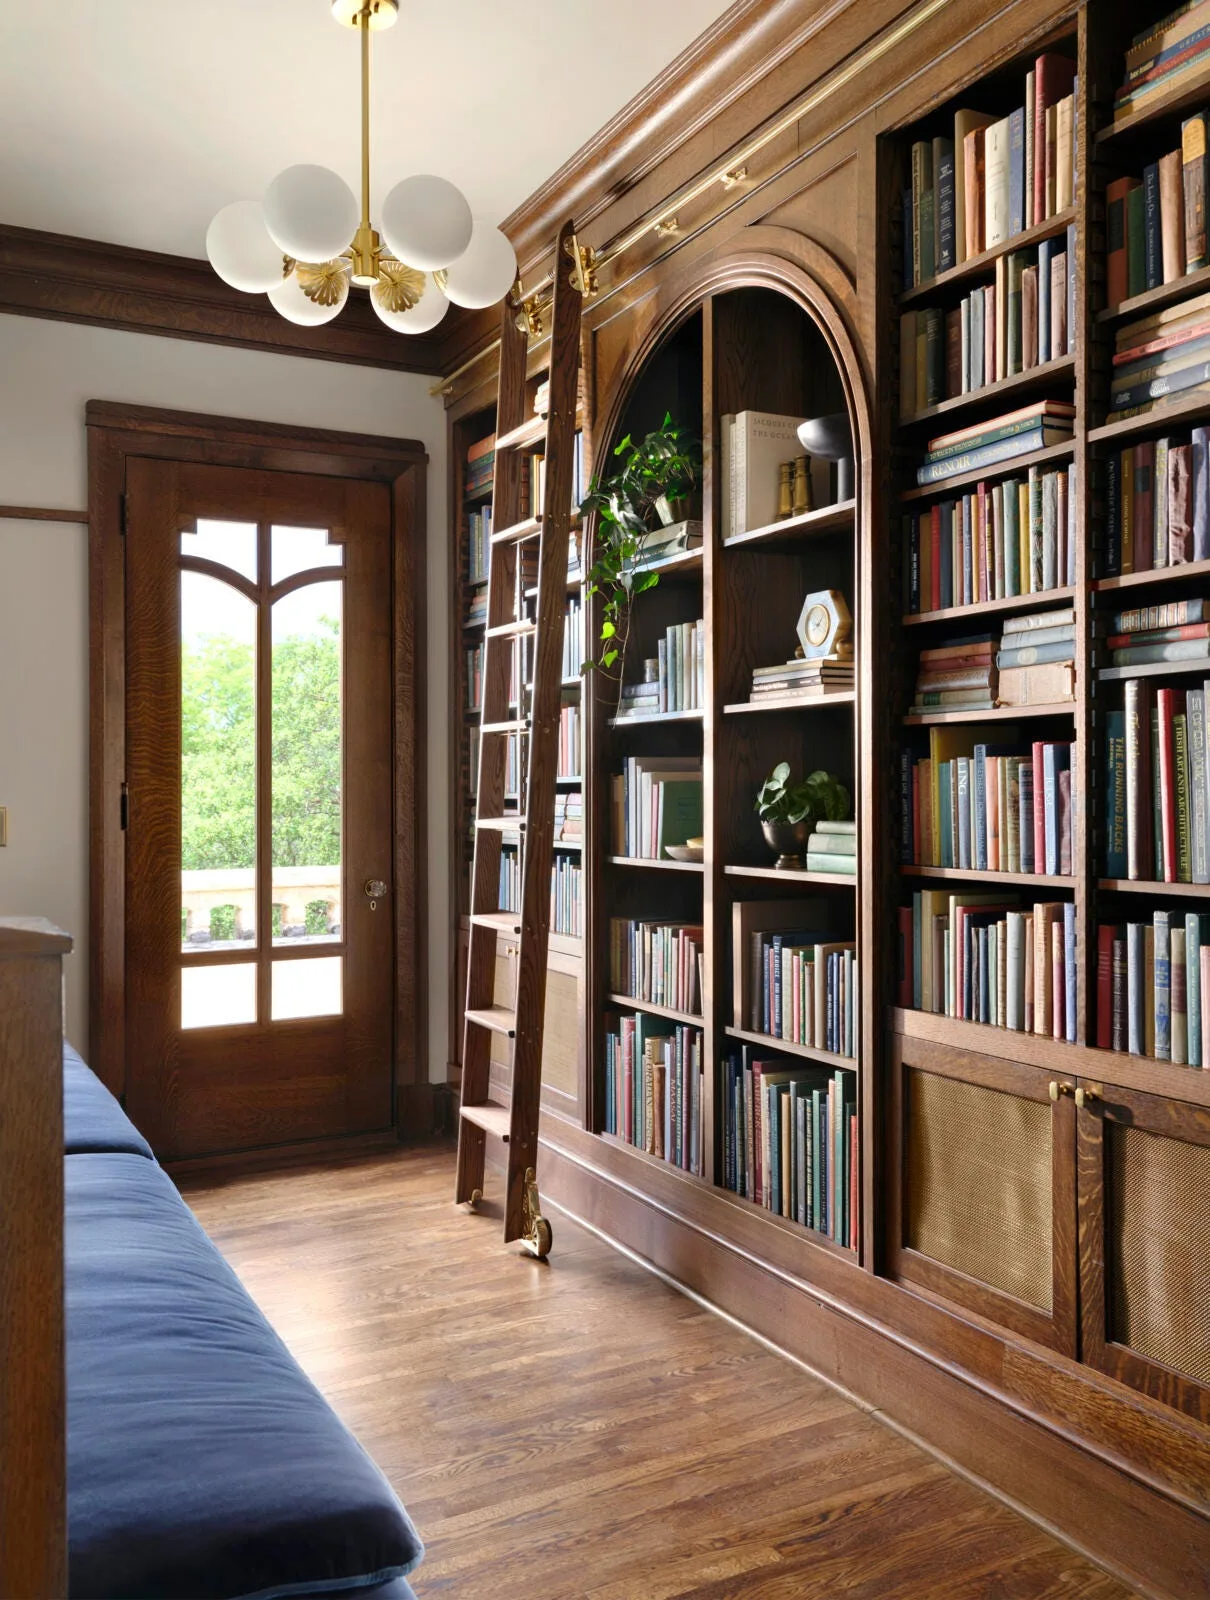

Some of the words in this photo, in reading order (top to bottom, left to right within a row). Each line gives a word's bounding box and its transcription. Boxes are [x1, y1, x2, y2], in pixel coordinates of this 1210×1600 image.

[753, 430, 768, 438] THE
[931, 455, 971, 477] RENOIR
[1115, 736, 1124, 759] THE
[1175, 727, 1183, 756] IRISH
[958, 761, 968, 795] LING
[1176, 756, 1184, 775] ART
[1115, 760, 1124, 812] RUNNING
[1177, 774, 1185, 794] AND
[1114, 812, 1124, 853] BACKS
[1178, 795, 1188, 869] ARCHITECTURE
